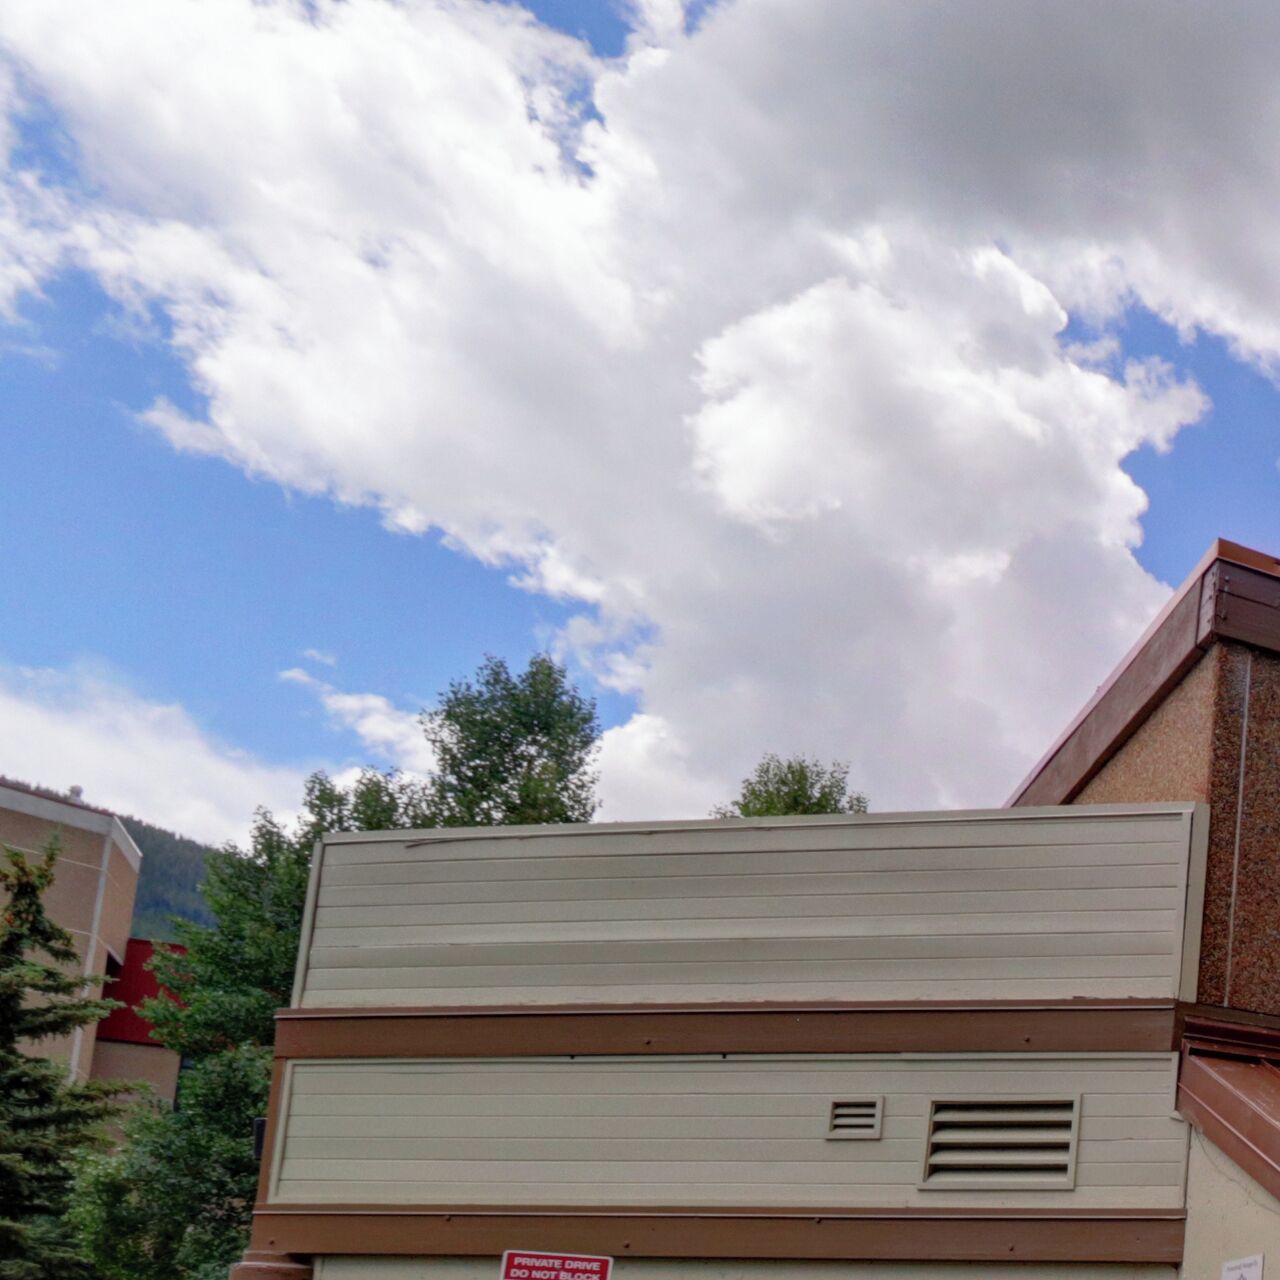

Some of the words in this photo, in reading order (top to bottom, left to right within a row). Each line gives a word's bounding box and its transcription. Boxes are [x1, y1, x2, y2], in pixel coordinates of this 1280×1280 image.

[513, 1257, 563, 1269] PRIVATE
[564, 1261, 601, 1271] DRIVE
[509, 1268, 529, 1278] DO
[531, 1270, 557, 1280] NOT
